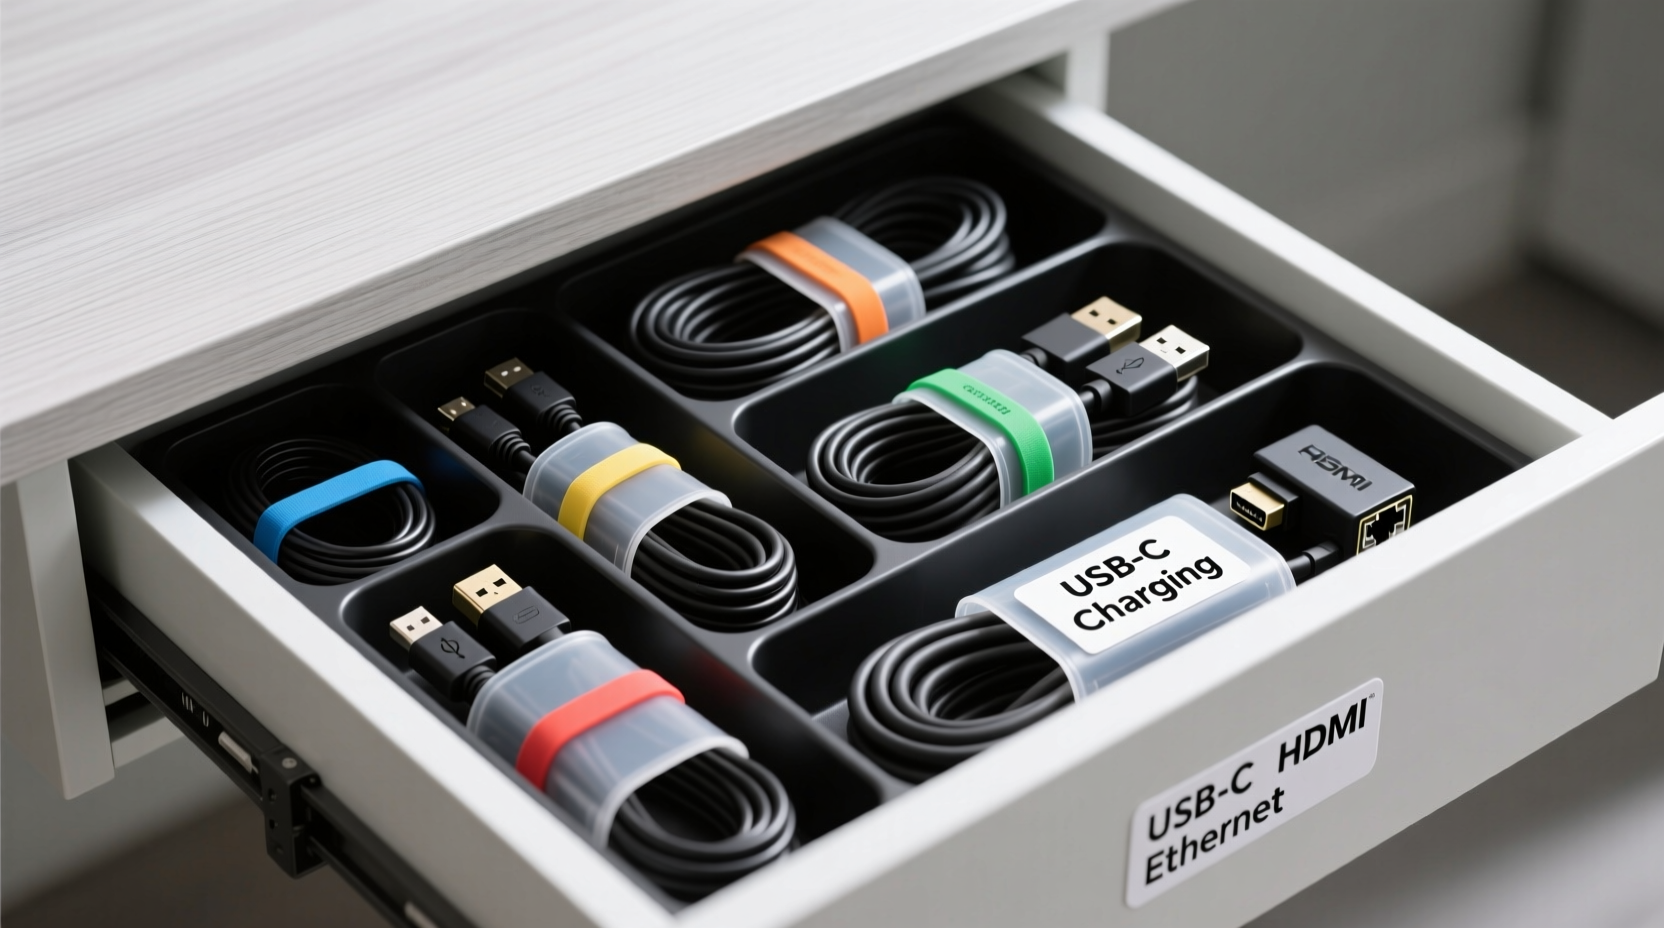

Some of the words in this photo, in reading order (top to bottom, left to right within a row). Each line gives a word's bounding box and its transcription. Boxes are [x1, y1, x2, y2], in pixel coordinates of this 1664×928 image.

[1060, 539, 1171, 597] USB-C
[1073, 555, 1223, 631] Charging
[1148, 762, 1254, 842] USB-C
[1278, 697, 1368, 774] HDMI
[1145, 786, 1285, 886] Ethernet
